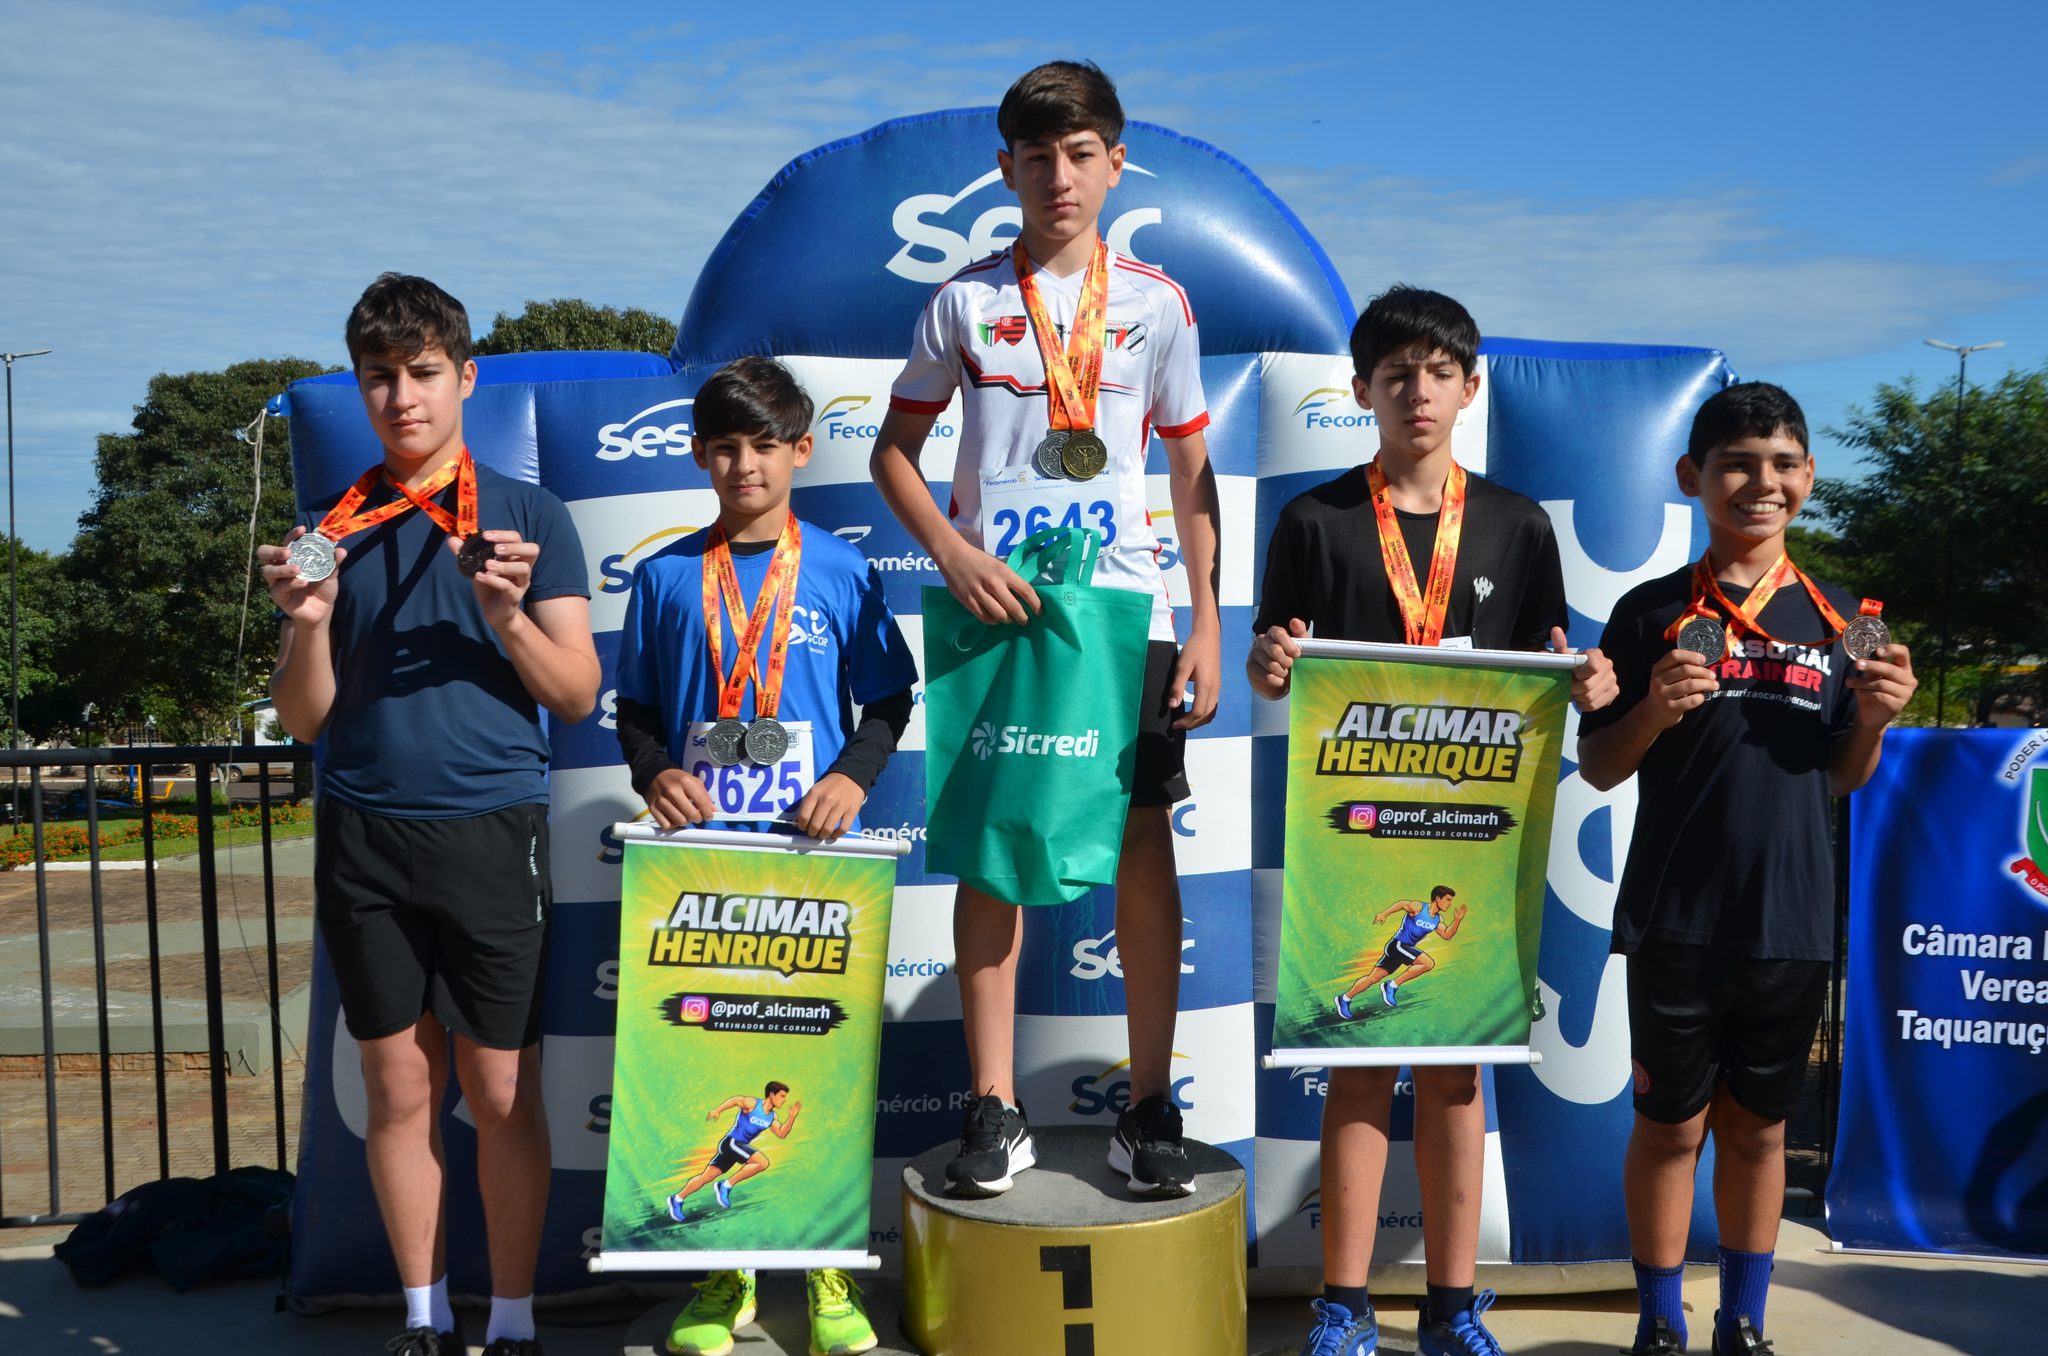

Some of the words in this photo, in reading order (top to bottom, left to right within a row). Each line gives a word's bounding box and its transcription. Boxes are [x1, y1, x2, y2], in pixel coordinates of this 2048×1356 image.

[884, 194, 1163, 284] Sec
[595, 422, 694, 461] Ses
[993, 499, 1117, 557] 2643
[997, 725, 1099, 758] Sicredi
[1338, 704, 1521, 746] ALCIMAR
[1322, 740, 1517, 782] HENRIQUE
[2005, 740, 2041, 780] PODER
[693, 760, 803, 814] 2625
[1378, 808, 1499, 826] @prof_alcimarh
[1381, 829, 1431, 837] TREINADOR
[1450, 831, 1490, 839] CORRIDA
[670, 894, 848, 937] ALCIMAR
[653, 930, 846, 974] HENRIQUE
[1902, 923, 2033, 961] Câmara
[711, 1000, 831, 1020] @prof_alcimarh
[714, 1022, 765, 1031] TREINADOR
[783, 1024, 822, 1033] CORRIDA
